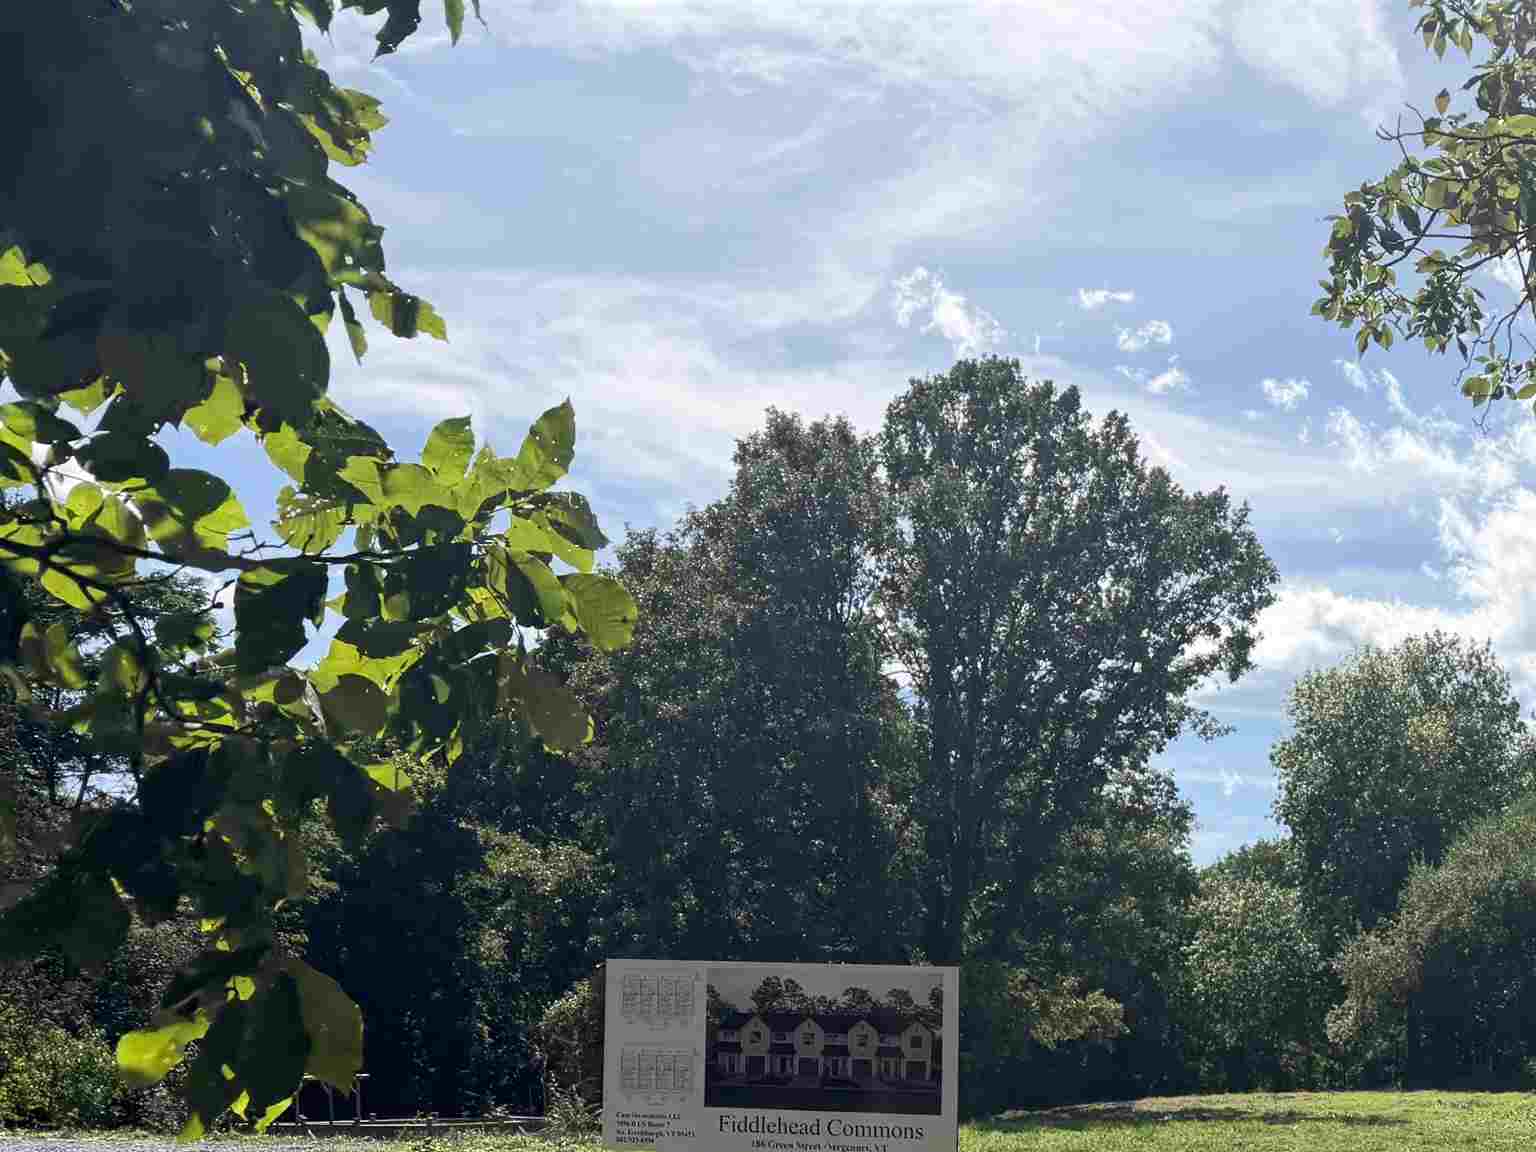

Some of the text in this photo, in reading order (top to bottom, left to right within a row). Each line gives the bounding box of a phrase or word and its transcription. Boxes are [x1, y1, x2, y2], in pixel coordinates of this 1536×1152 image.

[719, 1114, 820, 1136] Fiddlehead
[827, 1119, 924, 1140] Commons
[767, 1140, 794, 1150] Green
[874, 1143, 889, 1152] VT
